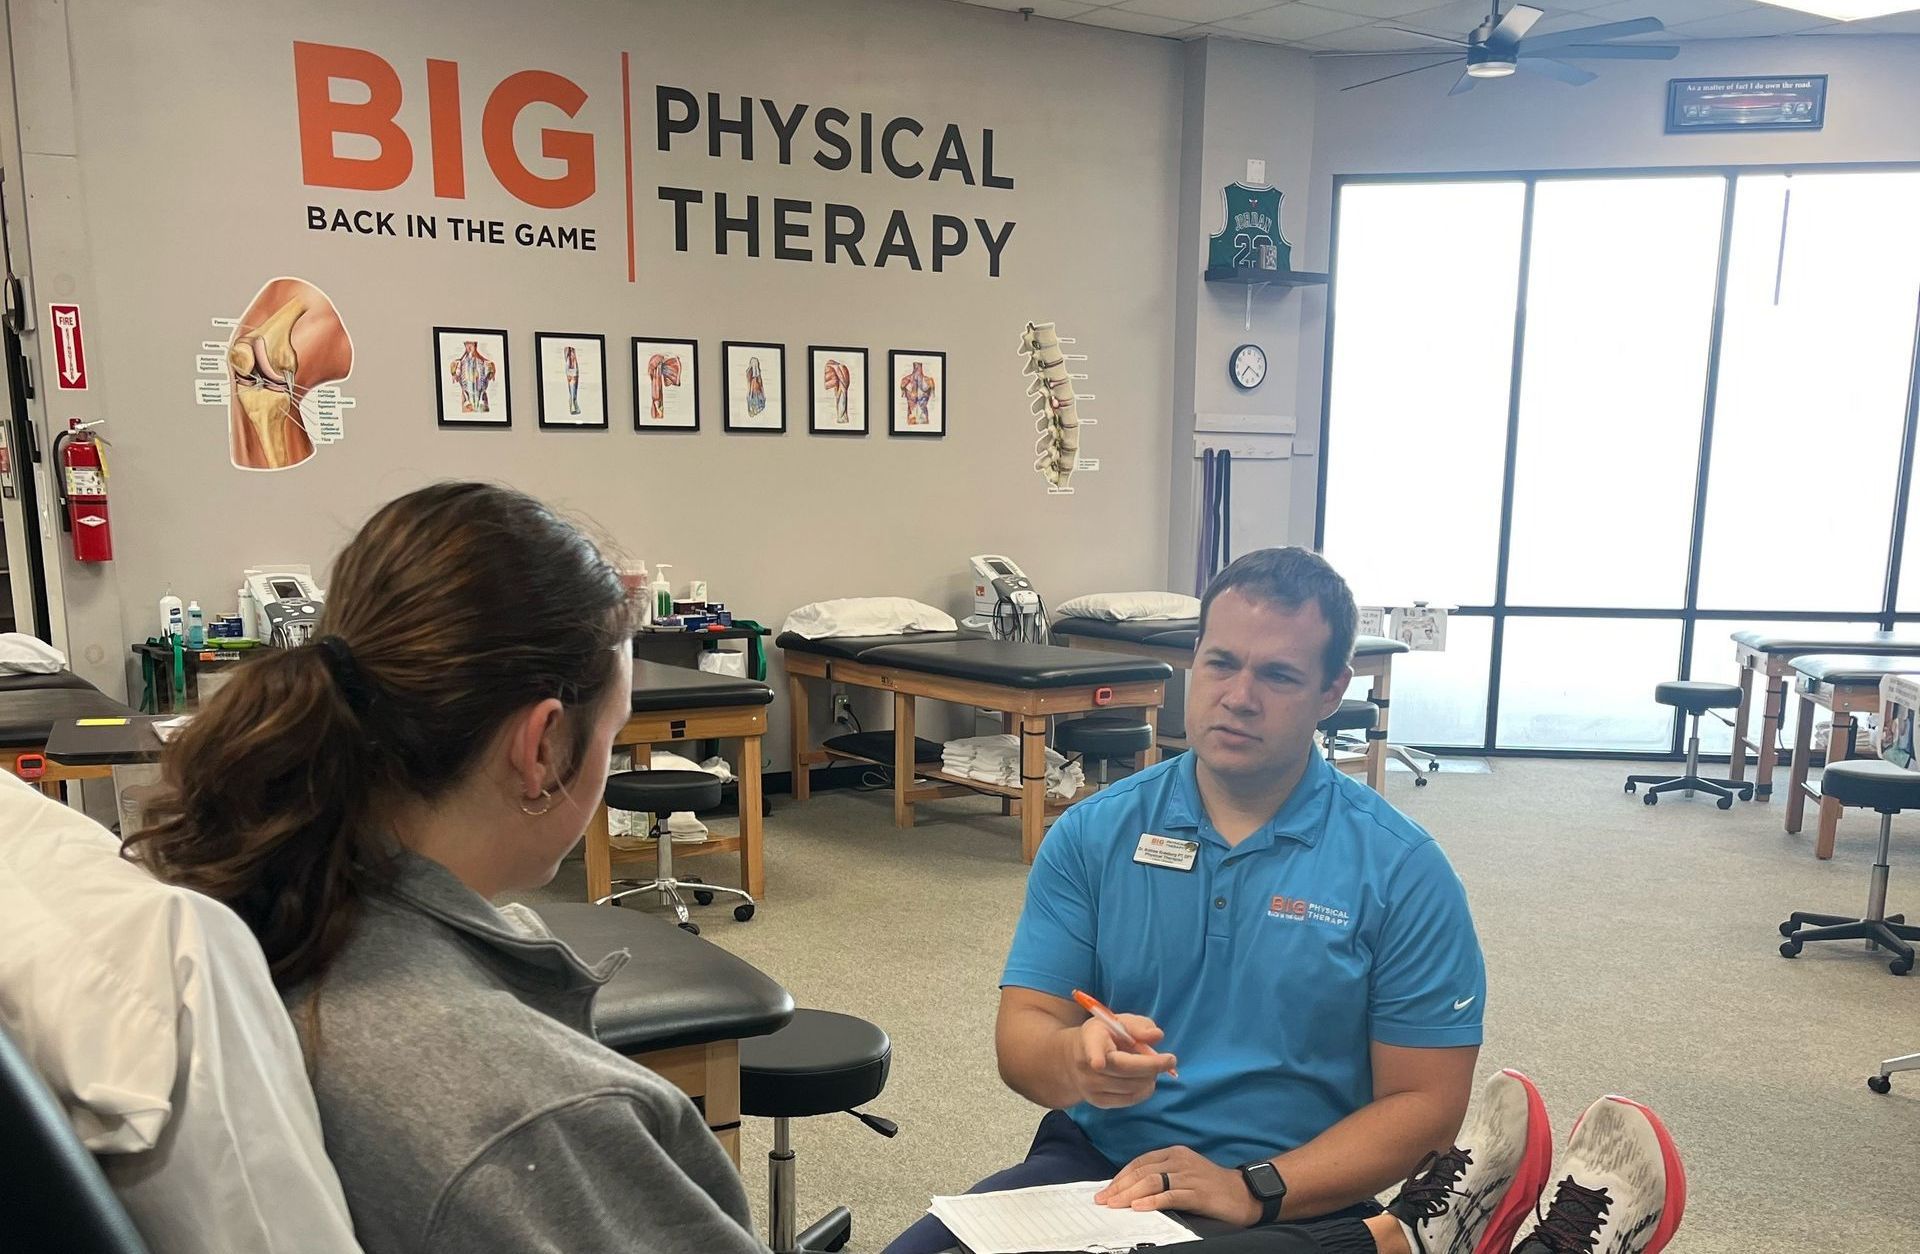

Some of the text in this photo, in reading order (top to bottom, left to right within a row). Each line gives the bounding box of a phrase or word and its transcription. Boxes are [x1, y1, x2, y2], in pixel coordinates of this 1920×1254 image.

[293, 40, 596, 209] BIG
[656, 85, 1014, 190] PHYSICAL
[307, 205, 597, 251] BACK IN THE GAME
[658, 186, 1017, 277] THERAPY
[1234, 211, 1273, 233] JORDAN
[59, 316, 74, 326] FIRE
[1271, 895, 1306, 914] BIG
[1308, 903, 1350, 919] PHYSICAL
[1307, 911, 1349, 926] THERAPY
